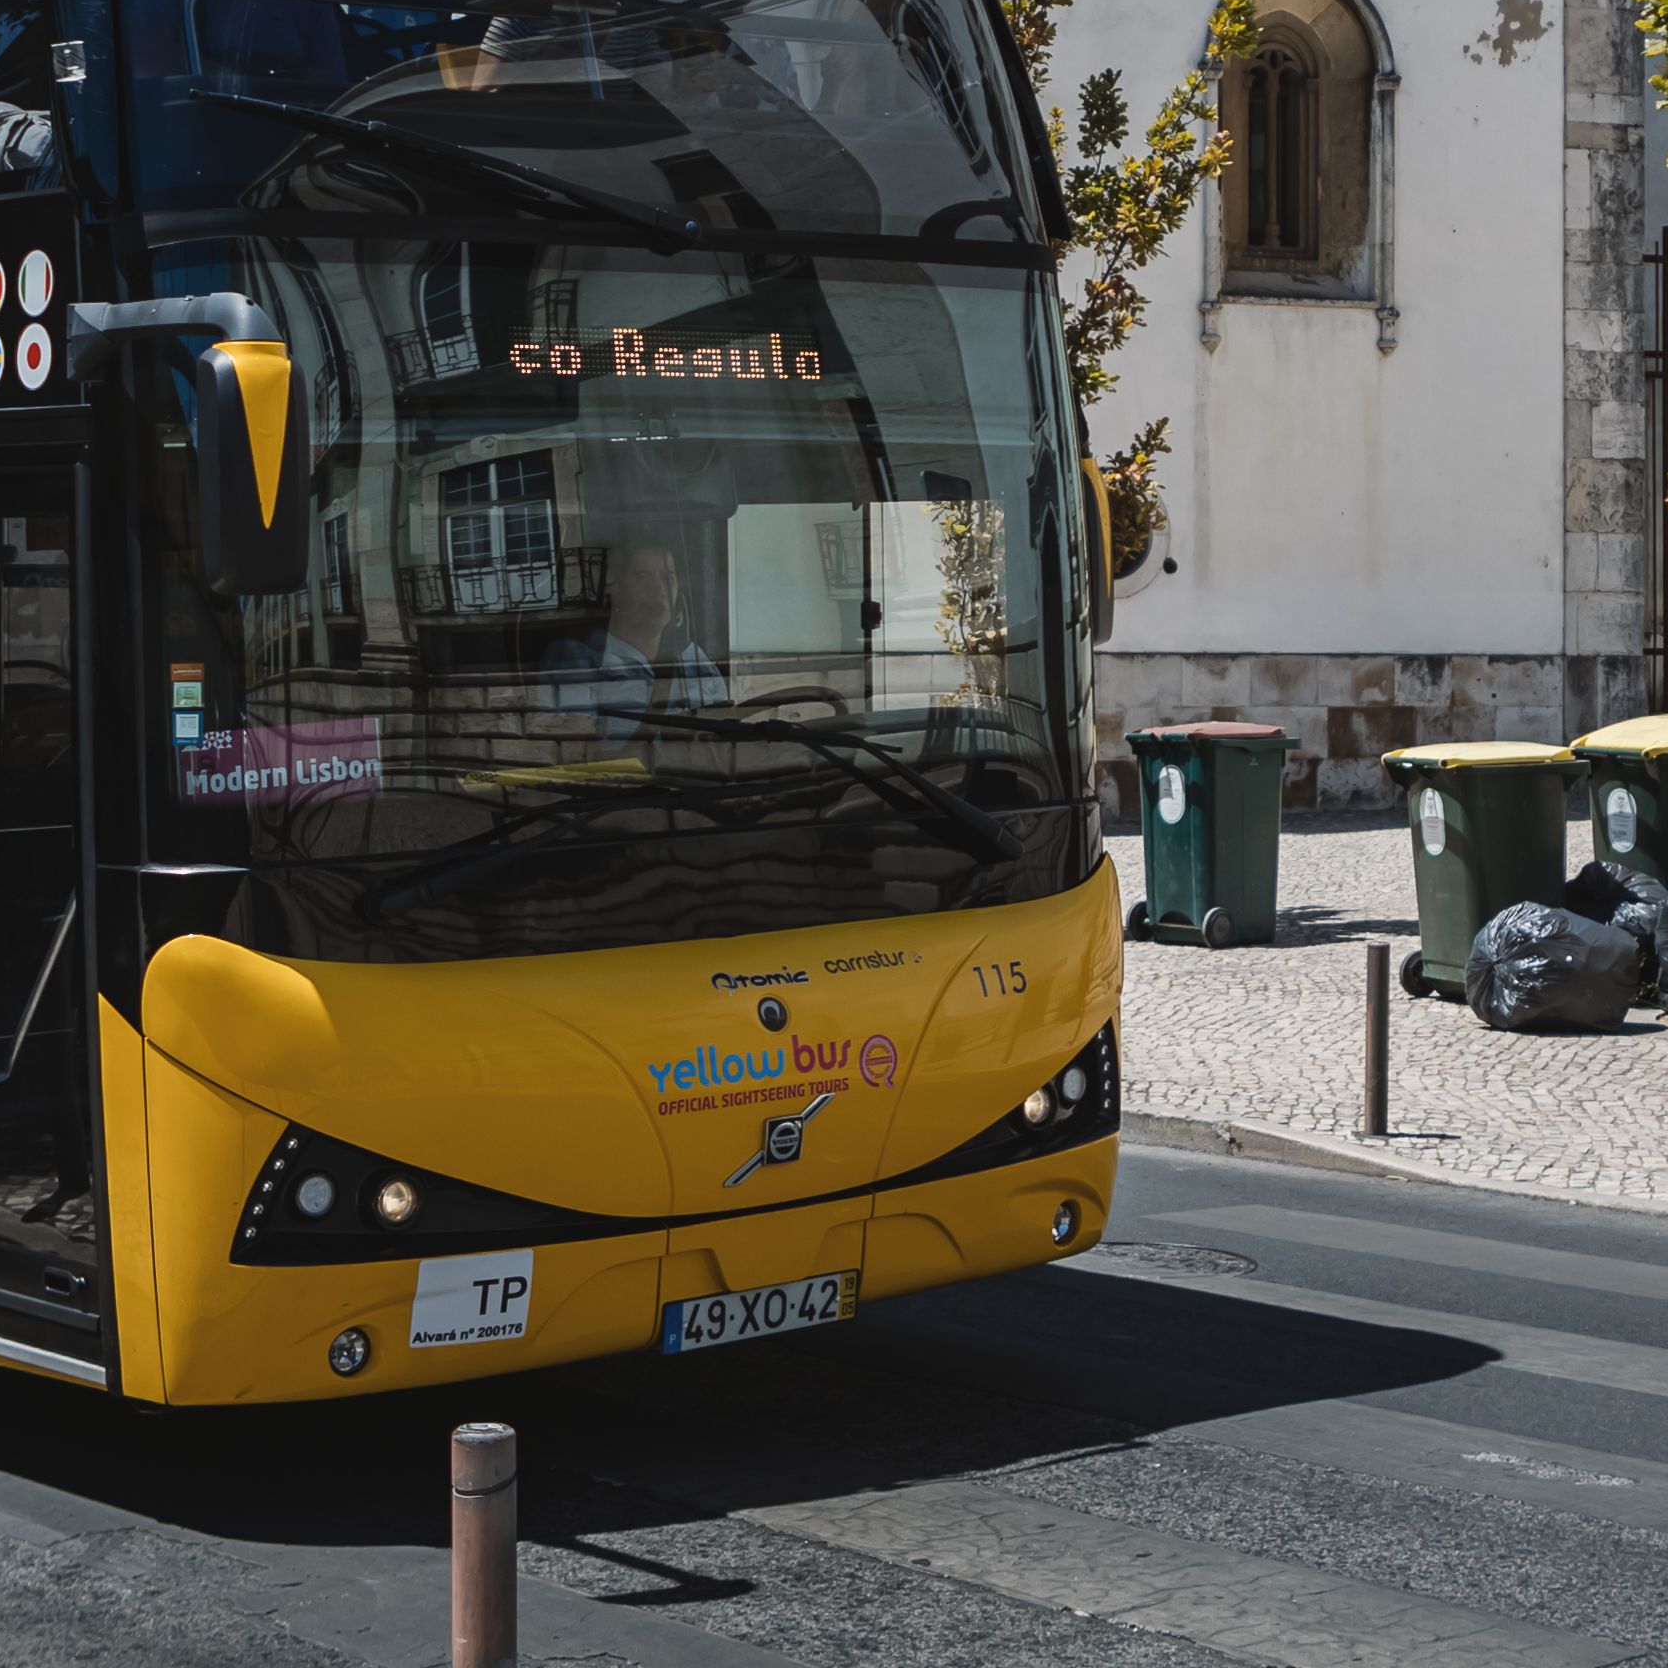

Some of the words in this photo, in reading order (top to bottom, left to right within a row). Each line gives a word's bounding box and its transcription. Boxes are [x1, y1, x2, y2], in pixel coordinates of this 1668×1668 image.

[186, 765, 288, 796] Modern
[296, 756, 381, 785] Lisbon
[824, 949, 905, 975] carristur
[973, 960, 1028, 998] 115
[648, 1044, 786, 1094] yellow
[791, 1033, 852, 1074] bus
[658, 1094, 718, 1116] OFFICIAL
[722, 1084, 805, 1109] SIGHTSEEING
[809, 1077, 850, 1098] TOURS
[472, 1275, 529, 1317] TP
[412, 1328, 456, 1344] Alvará
[476, 1322, 523, 1338] 200176
